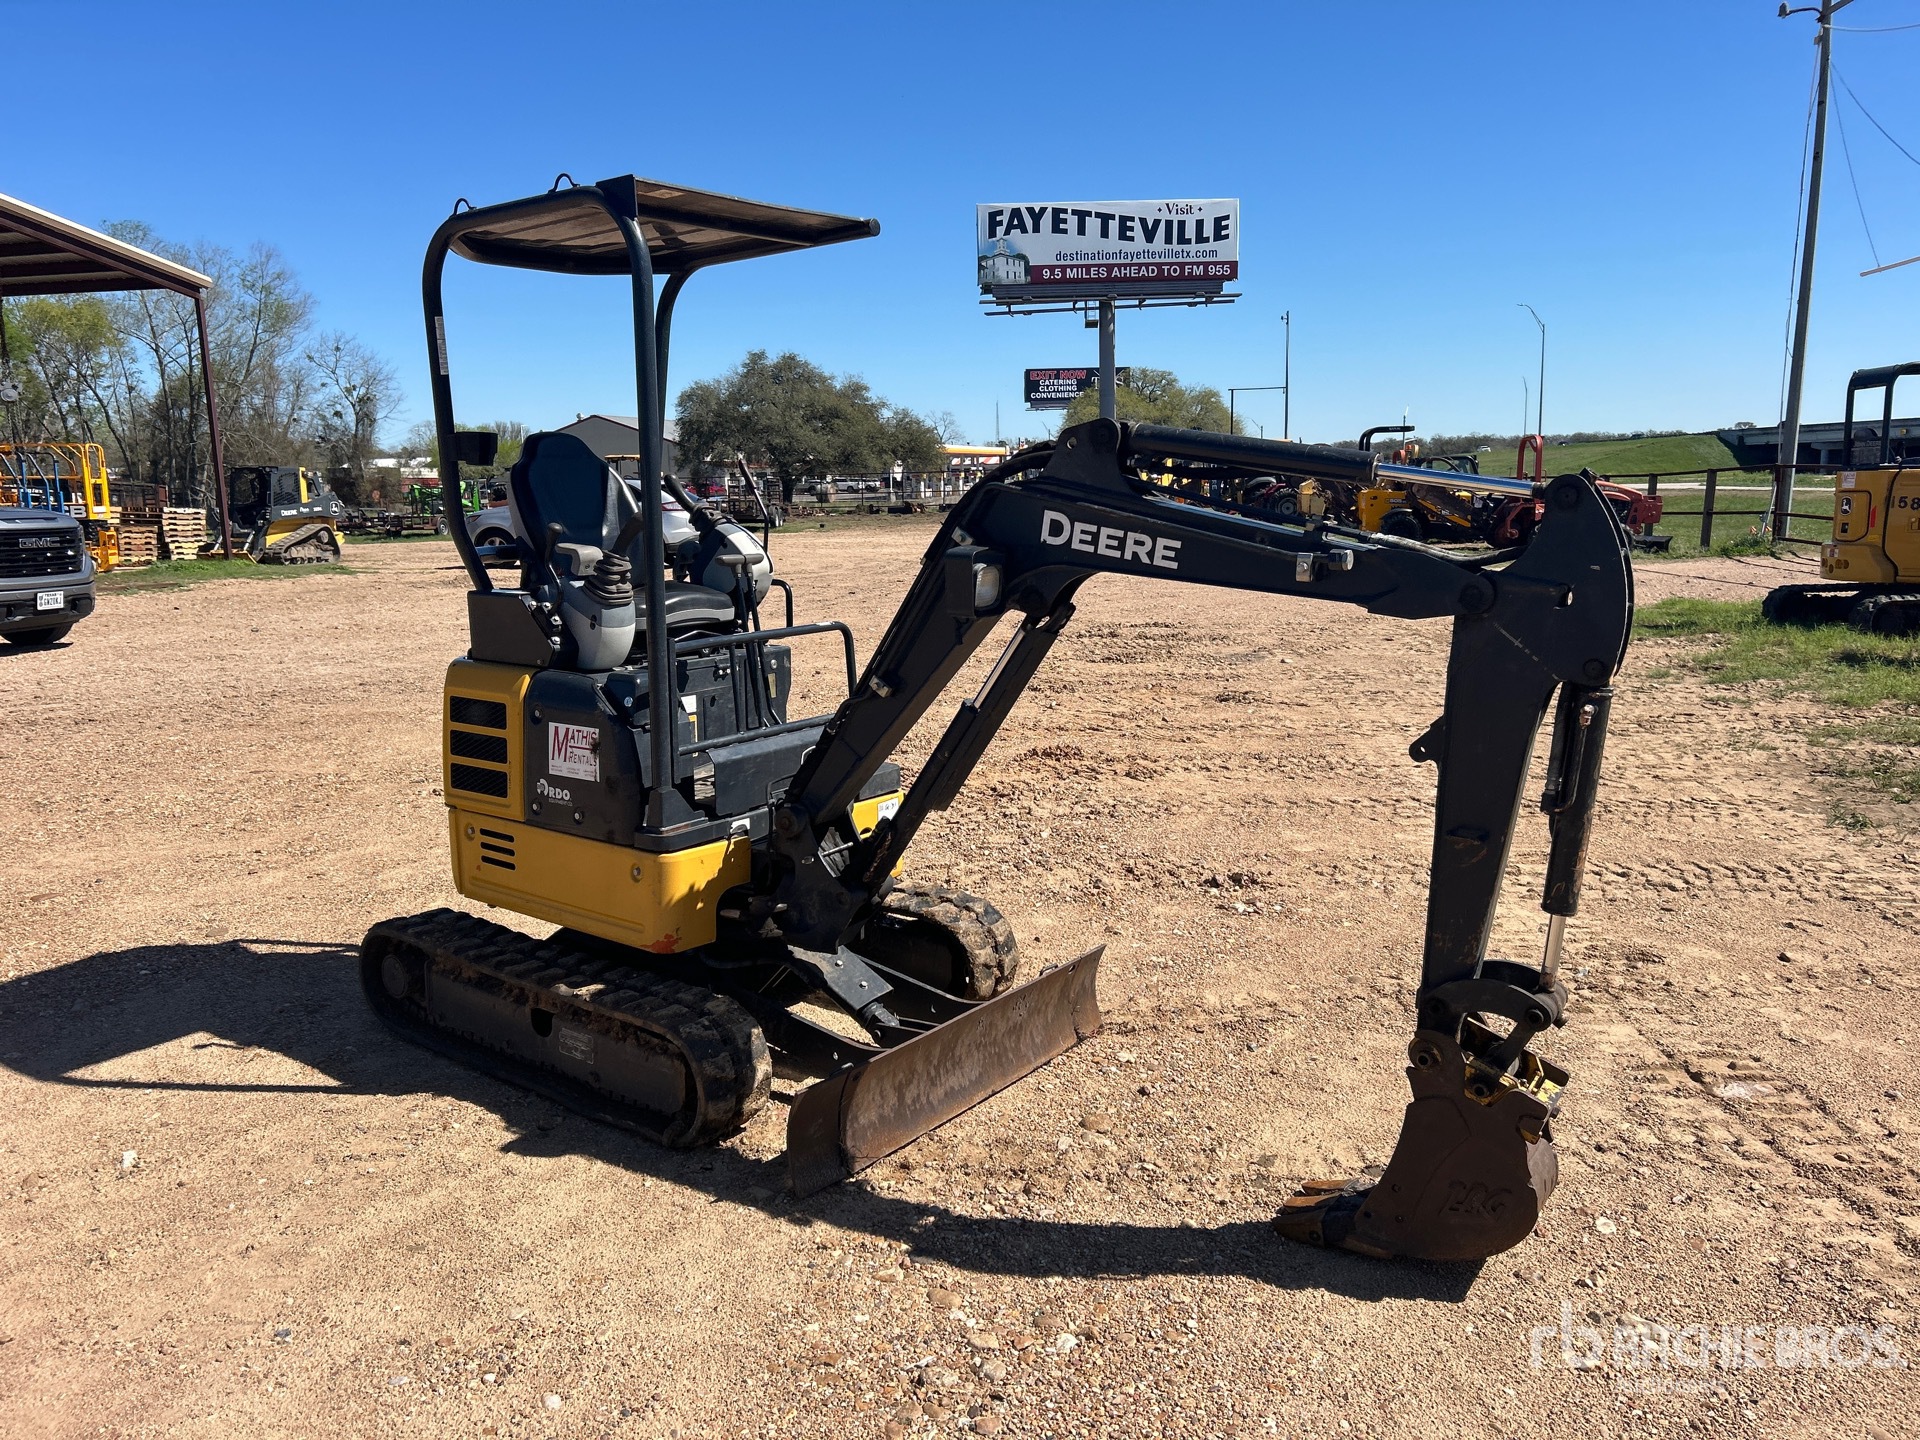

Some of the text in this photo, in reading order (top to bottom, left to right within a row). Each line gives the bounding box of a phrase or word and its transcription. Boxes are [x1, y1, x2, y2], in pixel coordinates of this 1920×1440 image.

[1164, 202, 1195, 216] Visit
[987, 206, 1231, 246] FAYETTEVILLE
[1055, 247, 1218, 263] destinationfayettevilletx.com
[1042, 264, 1231, 280] 9.5 MILES AHEAD TO FM 955
[1029, 369, 1087, 380] EXIT NOW
[1039, 378, 1077, 386] CATERING
[1030, 391, 1085, 399] CONVENIENCE
[19, 537, 60, 549] GMC
[1040, 509, 1182, 570] DEERE
[568, 750, 598, 767] RENTALS
[548, 786, 571, 801] RDO
